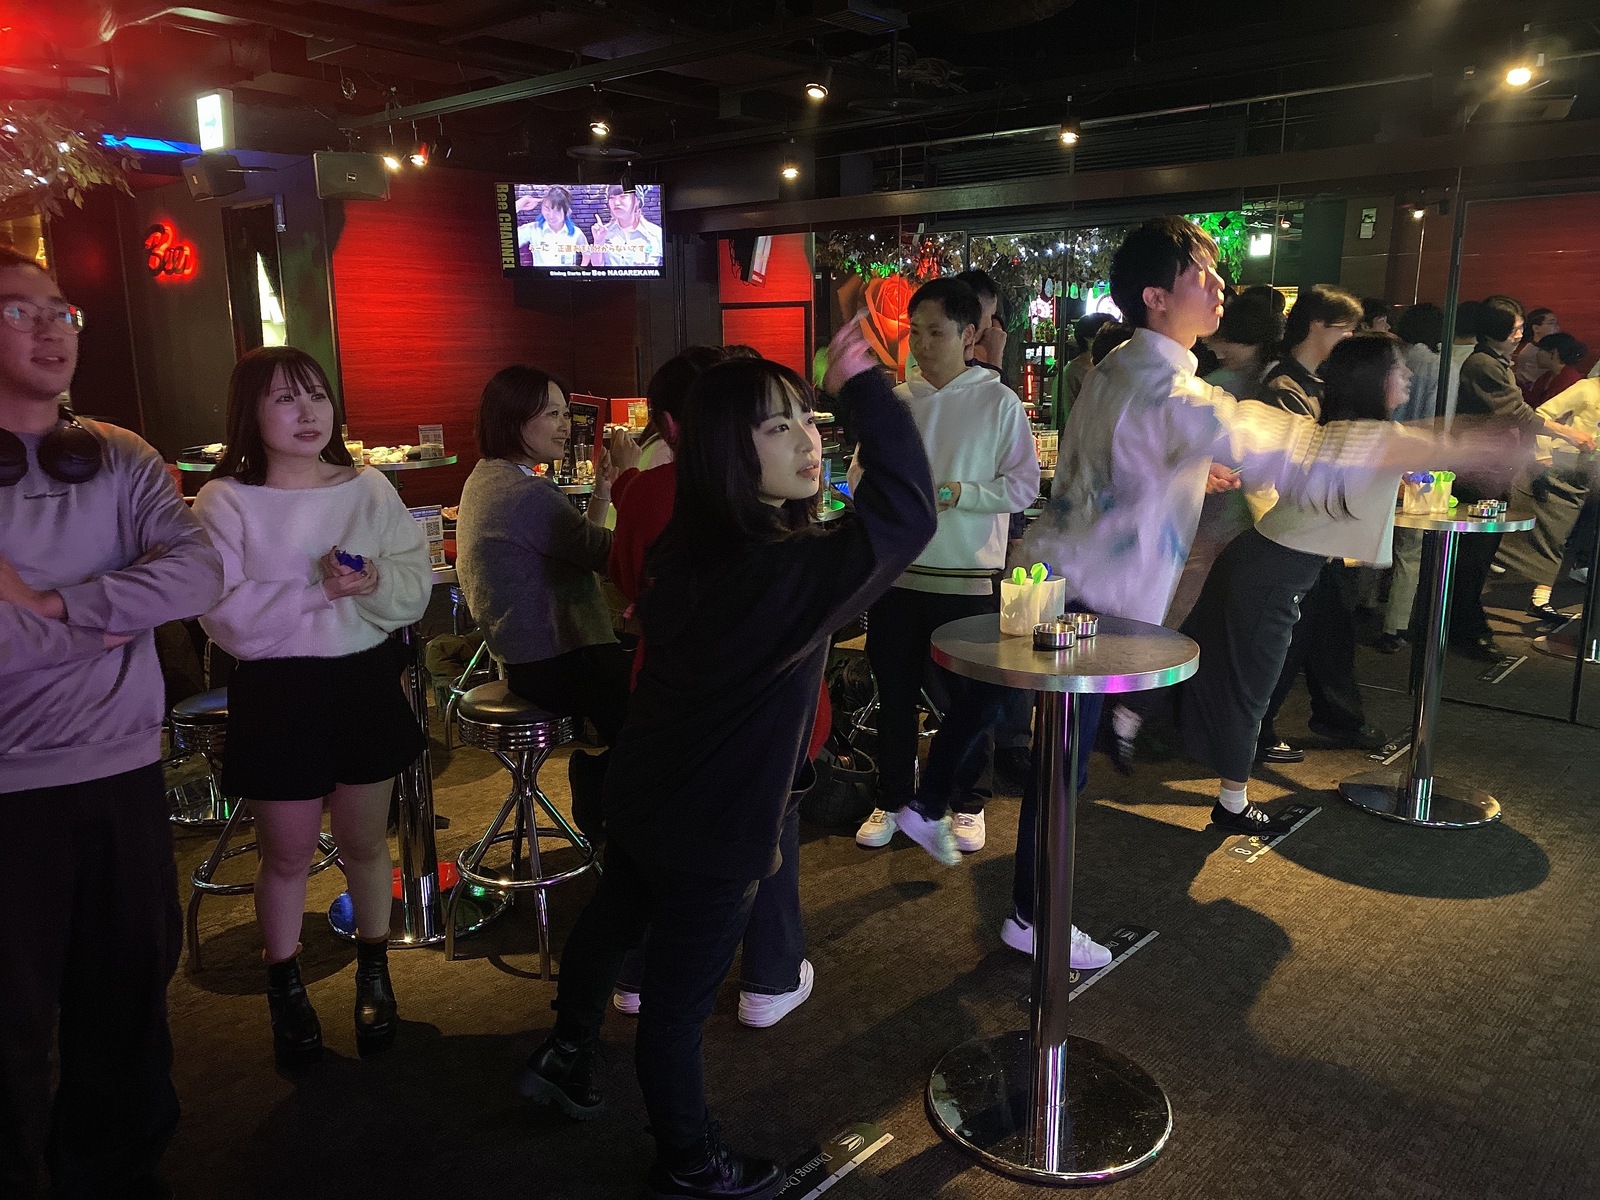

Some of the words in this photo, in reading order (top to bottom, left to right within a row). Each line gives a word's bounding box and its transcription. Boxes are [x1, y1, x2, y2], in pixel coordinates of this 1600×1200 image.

[496, 184, 509, 210] Bee
[499, 213, 515, 270] CHANNEL
[591, 269, 606, 277] Bee
[607, 269, 660, 277] NAGAREKAWA
[794, 1152, 833, 1177] Dining
